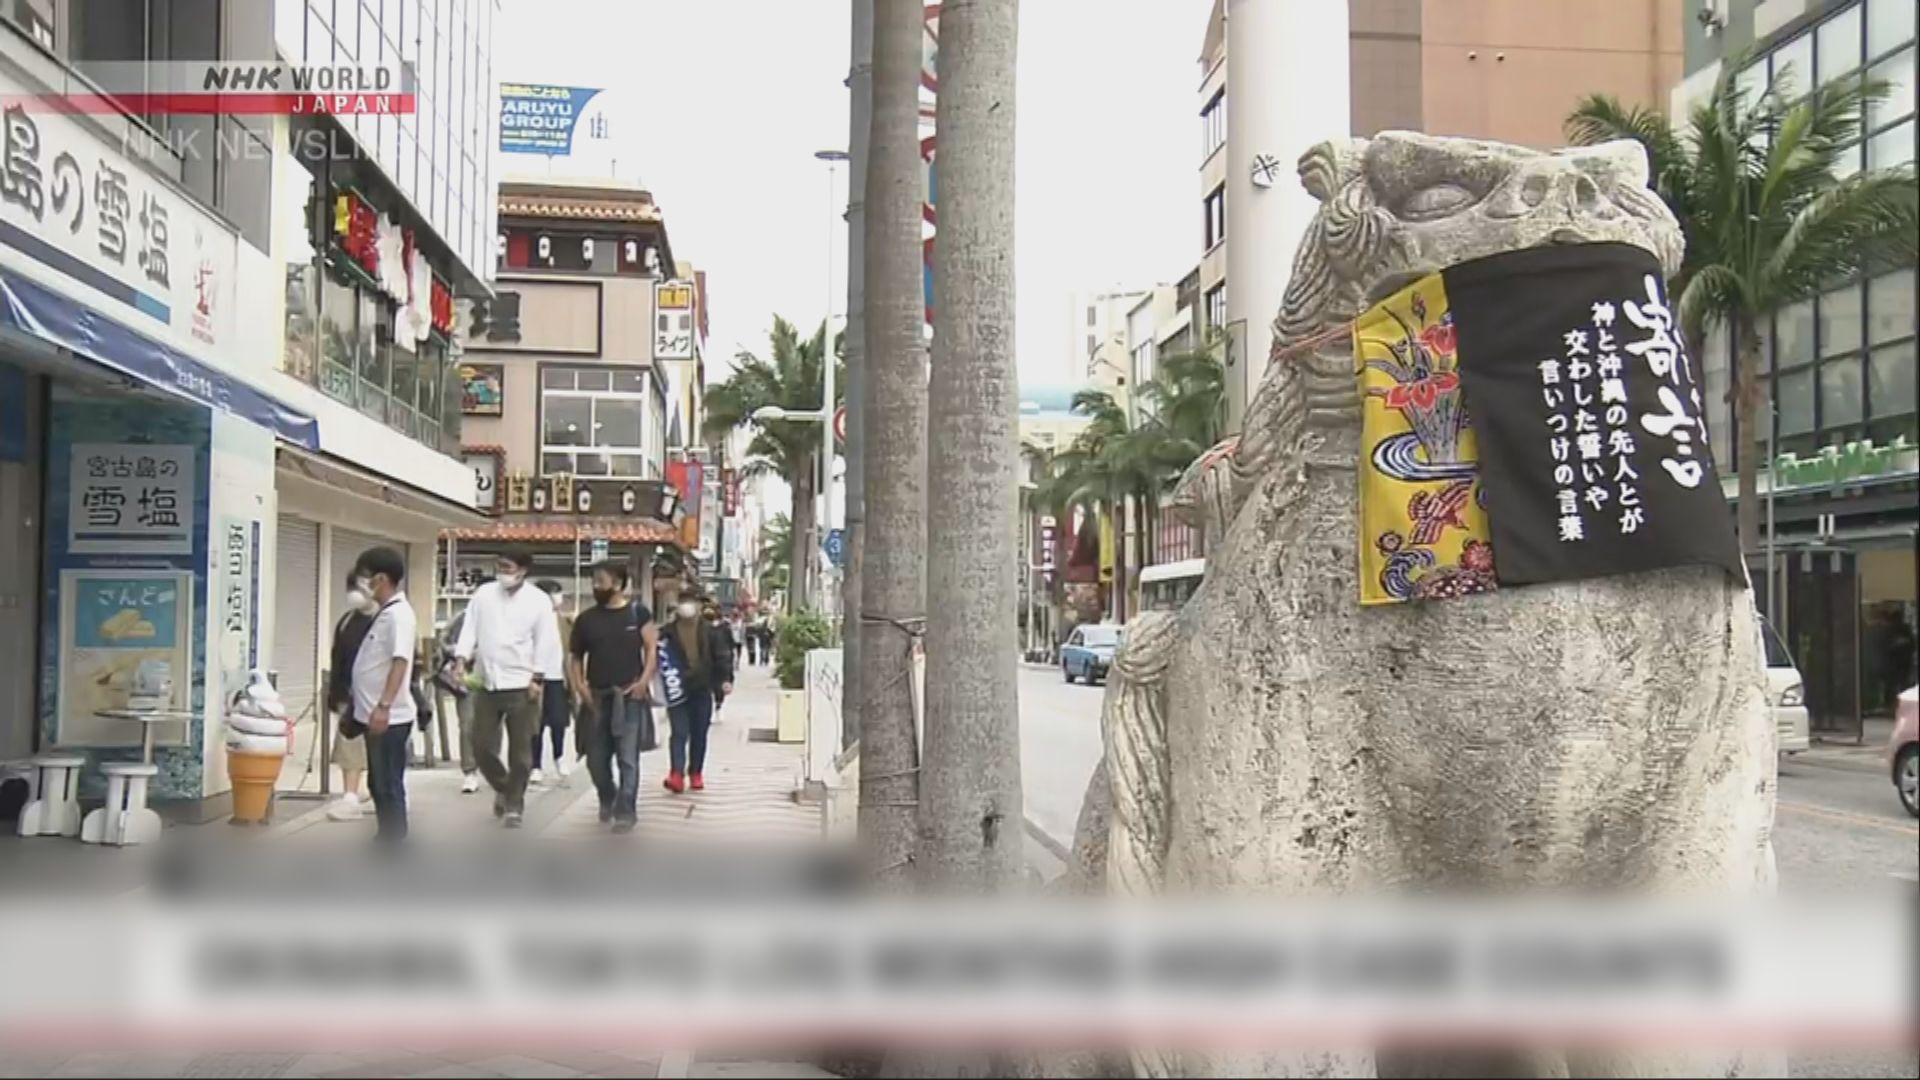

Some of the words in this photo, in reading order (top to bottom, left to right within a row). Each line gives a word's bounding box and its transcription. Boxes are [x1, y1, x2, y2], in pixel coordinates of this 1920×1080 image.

[501, 113, 573, 129] GROUP
[1563, 328, 1609, 512] 交わした誓いや
[87, 455, 178, 479] 宮古島の
[1537, 358, 1584, 542] 言いつけの言葉
[83, 485, 181, 528] 雪塩
